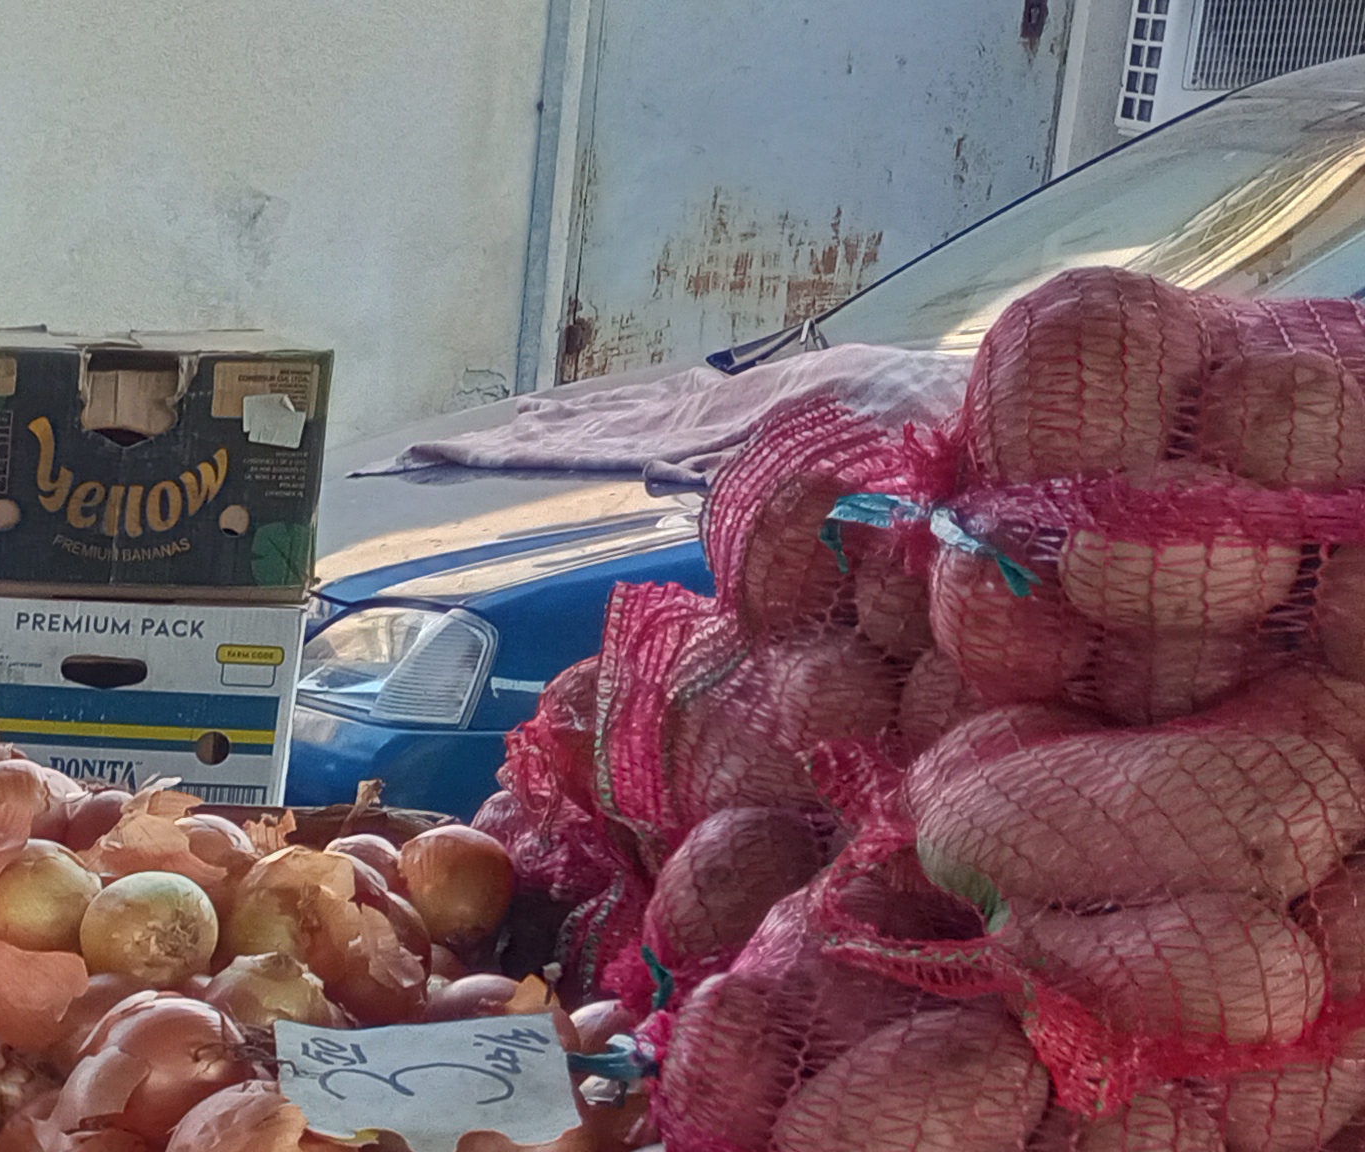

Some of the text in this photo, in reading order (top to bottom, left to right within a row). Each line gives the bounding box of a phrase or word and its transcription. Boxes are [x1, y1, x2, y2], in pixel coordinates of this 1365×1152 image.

[122, 538, 191, 562] BANANAS
[16, 612, 205, 639] PREMIUM PACK
